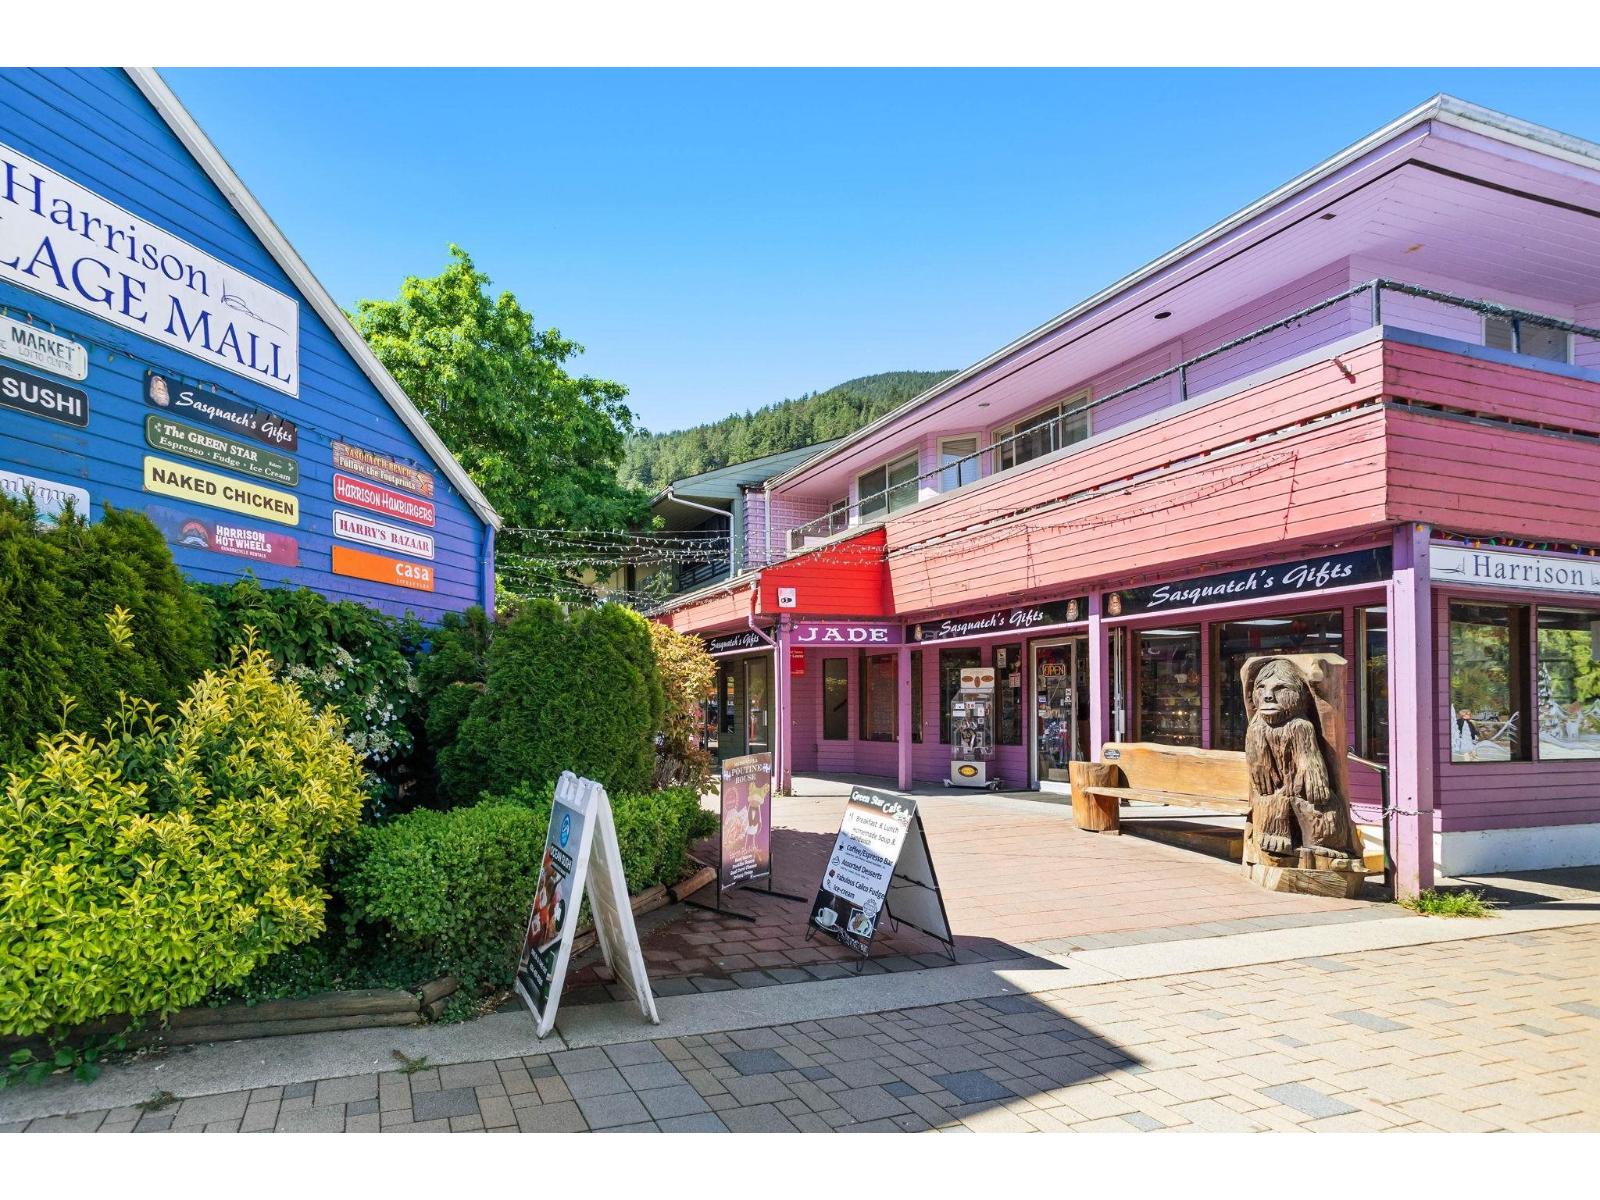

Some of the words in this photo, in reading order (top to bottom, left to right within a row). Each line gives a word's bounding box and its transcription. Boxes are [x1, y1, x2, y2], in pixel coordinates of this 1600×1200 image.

[1, 159, 209, 297] Harrison
[0, 215, 149, 325] AGE
[164, 294, 291, 385] MALL
[11, 325, 75, 361] MARKET
[2, 376, 81, 417] SUSHI
[175, 391, 256, 430] Sasquatch's
[261, 421, 292, 443] Gifts
[159, 436, 205, 457] Espresso
[212, 452, 240, 468] Fudge
[249, 462, 263, 473] Ice
[264, 467, 291, 482] Cream
[163, 423, 185, 440] The
[188, 432, 228, 452] GREEN
[230, 444, 258, 462] STAR
[338, 456, 365, 473] Follow
[366, 465, 380, 477] the
[380, 470, 416, 490] Footprints
[152, 466, 217, 496] NAKED
[222, 485, 294, 516] CHICKEN
[215, 523, 265, 543] HARRISON
[215, 534, 236, 549] HOT
[236, 537, 272, 554] WHEELS
[339, 518, 386, 541] HARRY'S
[391, 532, 430, 553] BAZAAR
[1147, 569, 1274, 608] Sasquatch's
[1282, 561, 1353, 588] Gifts
[1472, 554, 1585, 586] Harrison
[798, 627, 889, 642] JADE
[938, 613, 1005, 636] Sasquatch's
[1009, 609, 1044, 627] Gifts
[1043, 664, 1066, 678] OPEN
[731, 763, 763, 778] POUTINE
[735, 775, 757, 785] HOUSE
[851, 791, 870, 804] Green
